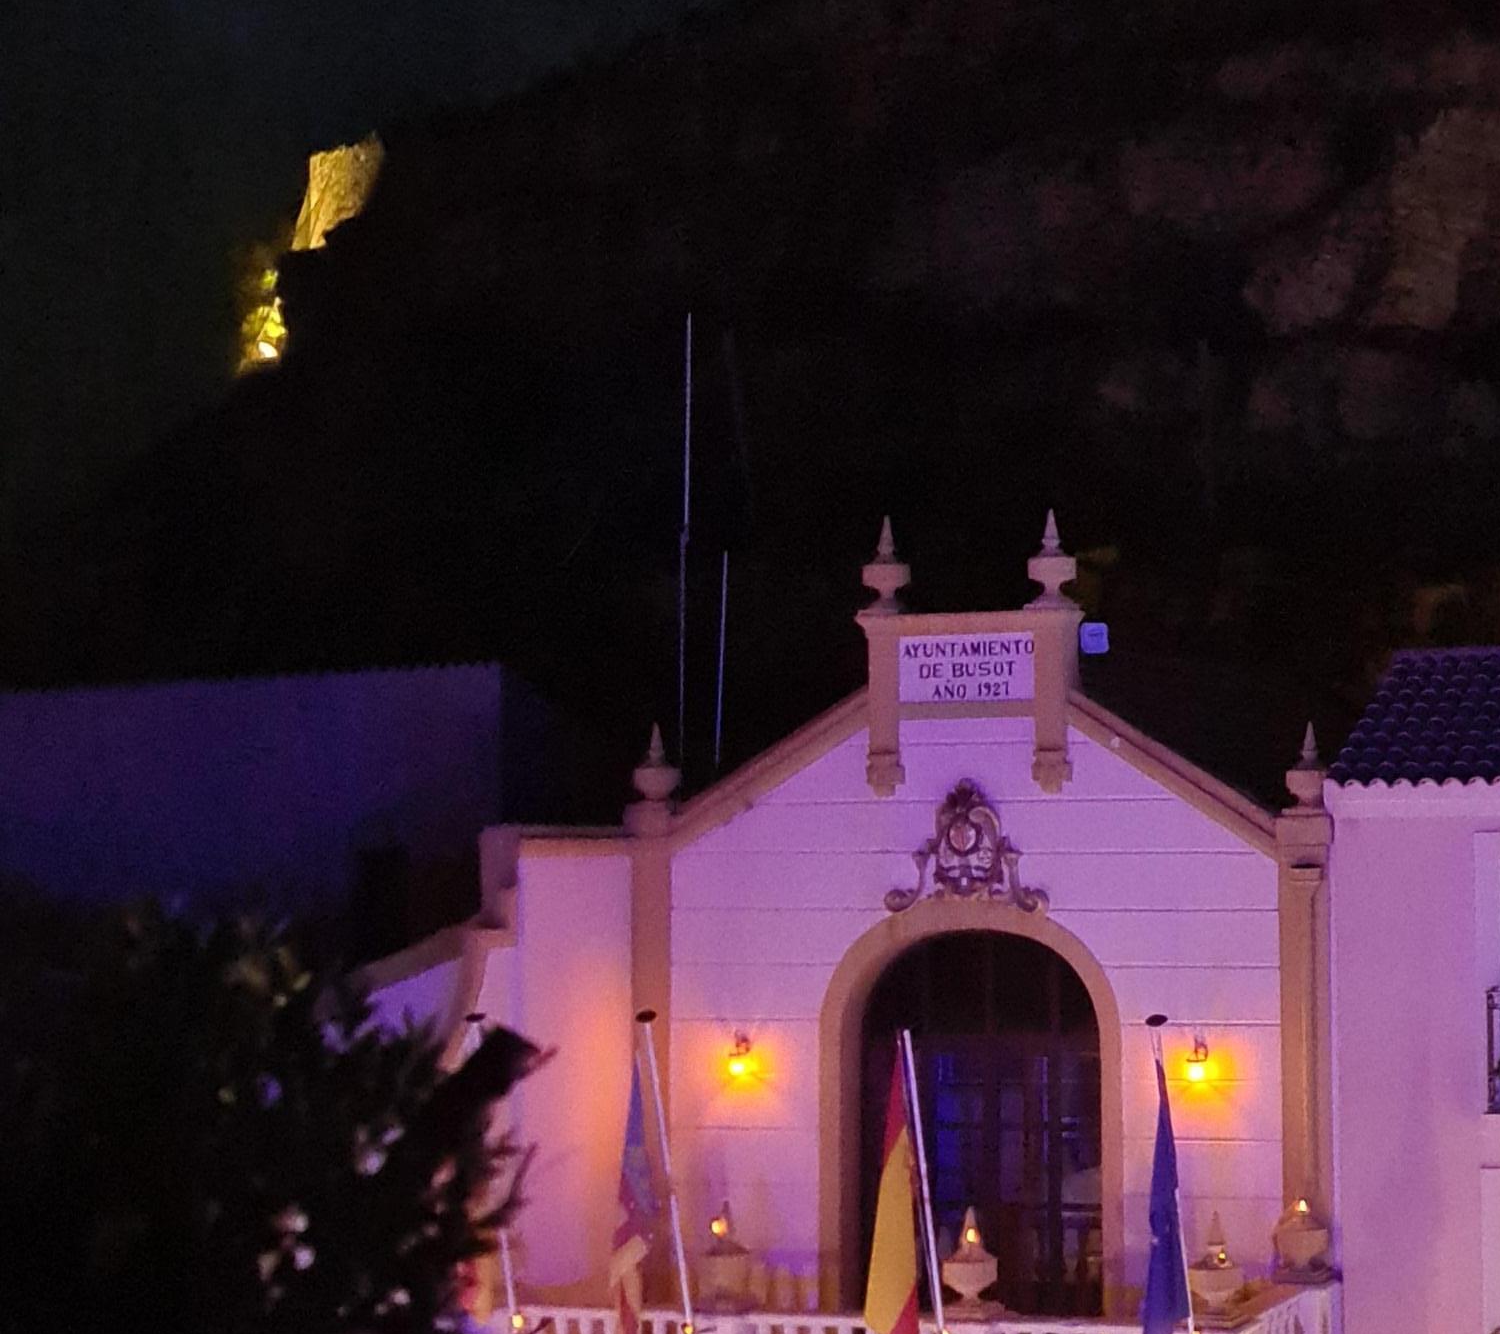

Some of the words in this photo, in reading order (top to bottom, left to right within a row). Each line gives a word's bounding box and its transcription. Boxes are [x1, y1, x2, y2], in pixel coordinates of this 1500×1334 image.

[903, 639, 1035, 658] AYUNTAMIENTO
[919, 663, 943, 679] DE
[951, 661, 1015, 678] BUSOT
[932, 679, 967, 699] AÑO
[978, 681, 1009, 697] 1927
